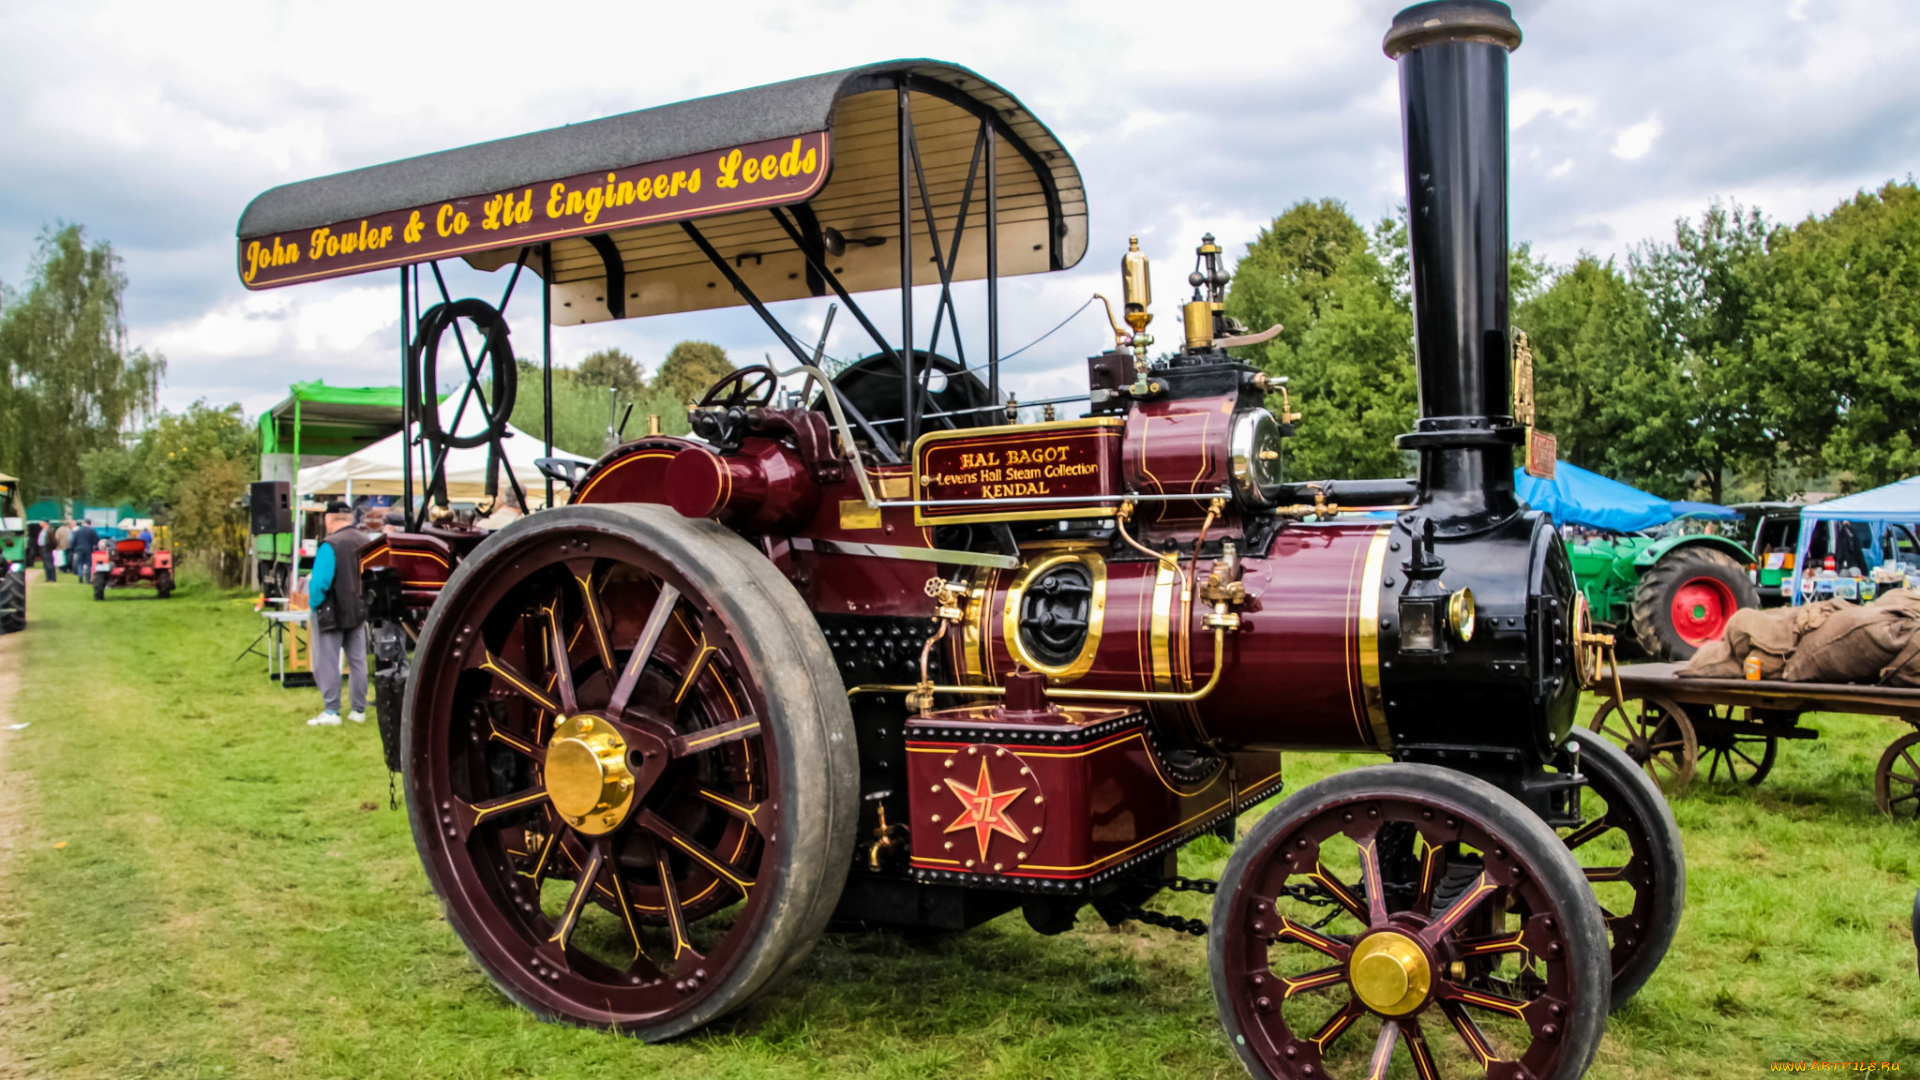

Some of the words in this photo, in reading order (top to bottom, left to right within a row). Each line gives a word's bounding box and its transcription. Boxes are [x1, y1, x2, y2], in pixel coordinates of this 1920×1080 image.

[244, 237, 300, 282] John
[310, 221, 393, 260] Fowler
[403, 211, 426, 244] &
[437, 203, 470, 238] Co
[482, 188, 534, 231] Ltd
[546, 167, 702, 224] Engineers
[716, 139, 818, 189] Leeds
[961, 452, 1000, 470] HAL
[1007, 446, 1069, 465] BAGOT
[937, 472, 978, 486] Levens
[980, 468, 1002, 482] Hall
[1006, 467, 1041, 480] Steam
[1044, 462, 1099, 478] Collection
[982, 481, 1050, 499] KENDAL
